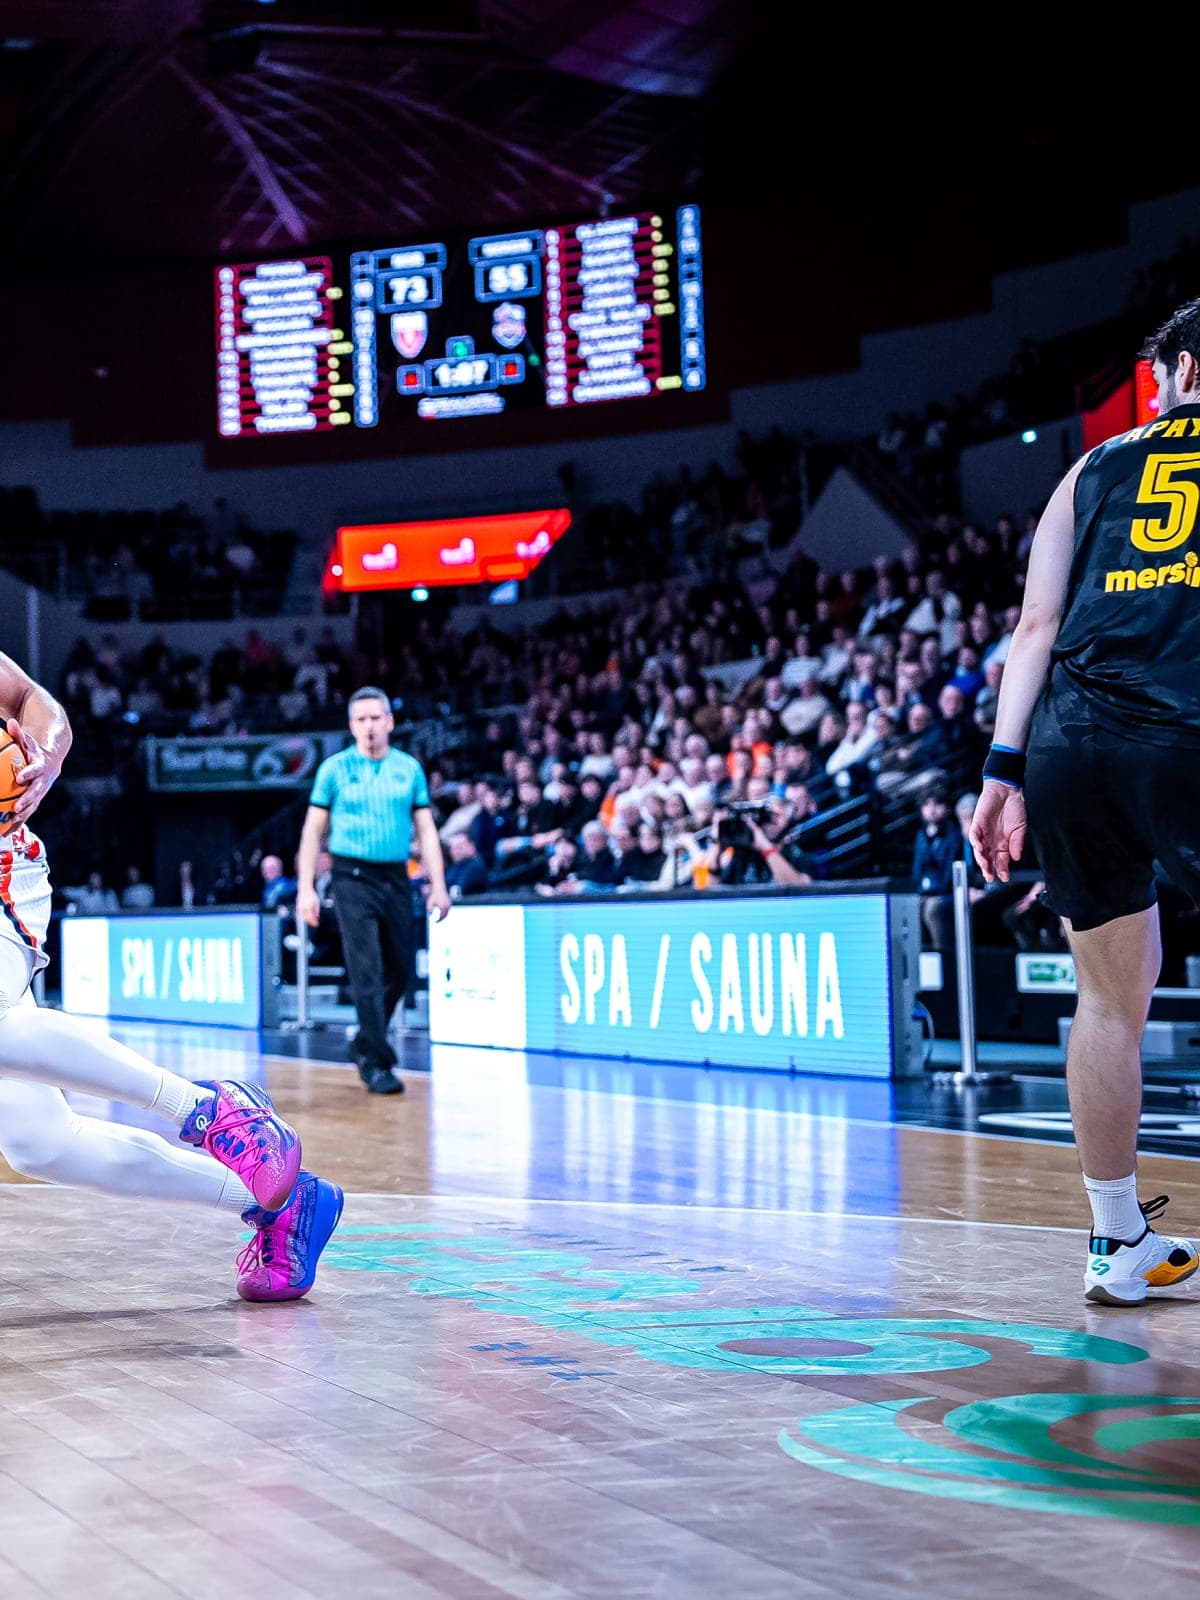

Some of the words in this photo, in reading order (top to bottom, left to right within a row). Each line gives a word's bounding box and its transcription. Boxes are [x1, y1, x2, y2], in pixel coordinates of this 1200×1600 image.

[389, 276, 429, 304] 73
[1130, 452, 1200, 552] 5
[122, 937, 156, 999] SPA
[178, 937, 245, 1004] SAUNA
[560, 932, 633, 1029] SPA
[690, 932, 845, 1040] SAUNA
